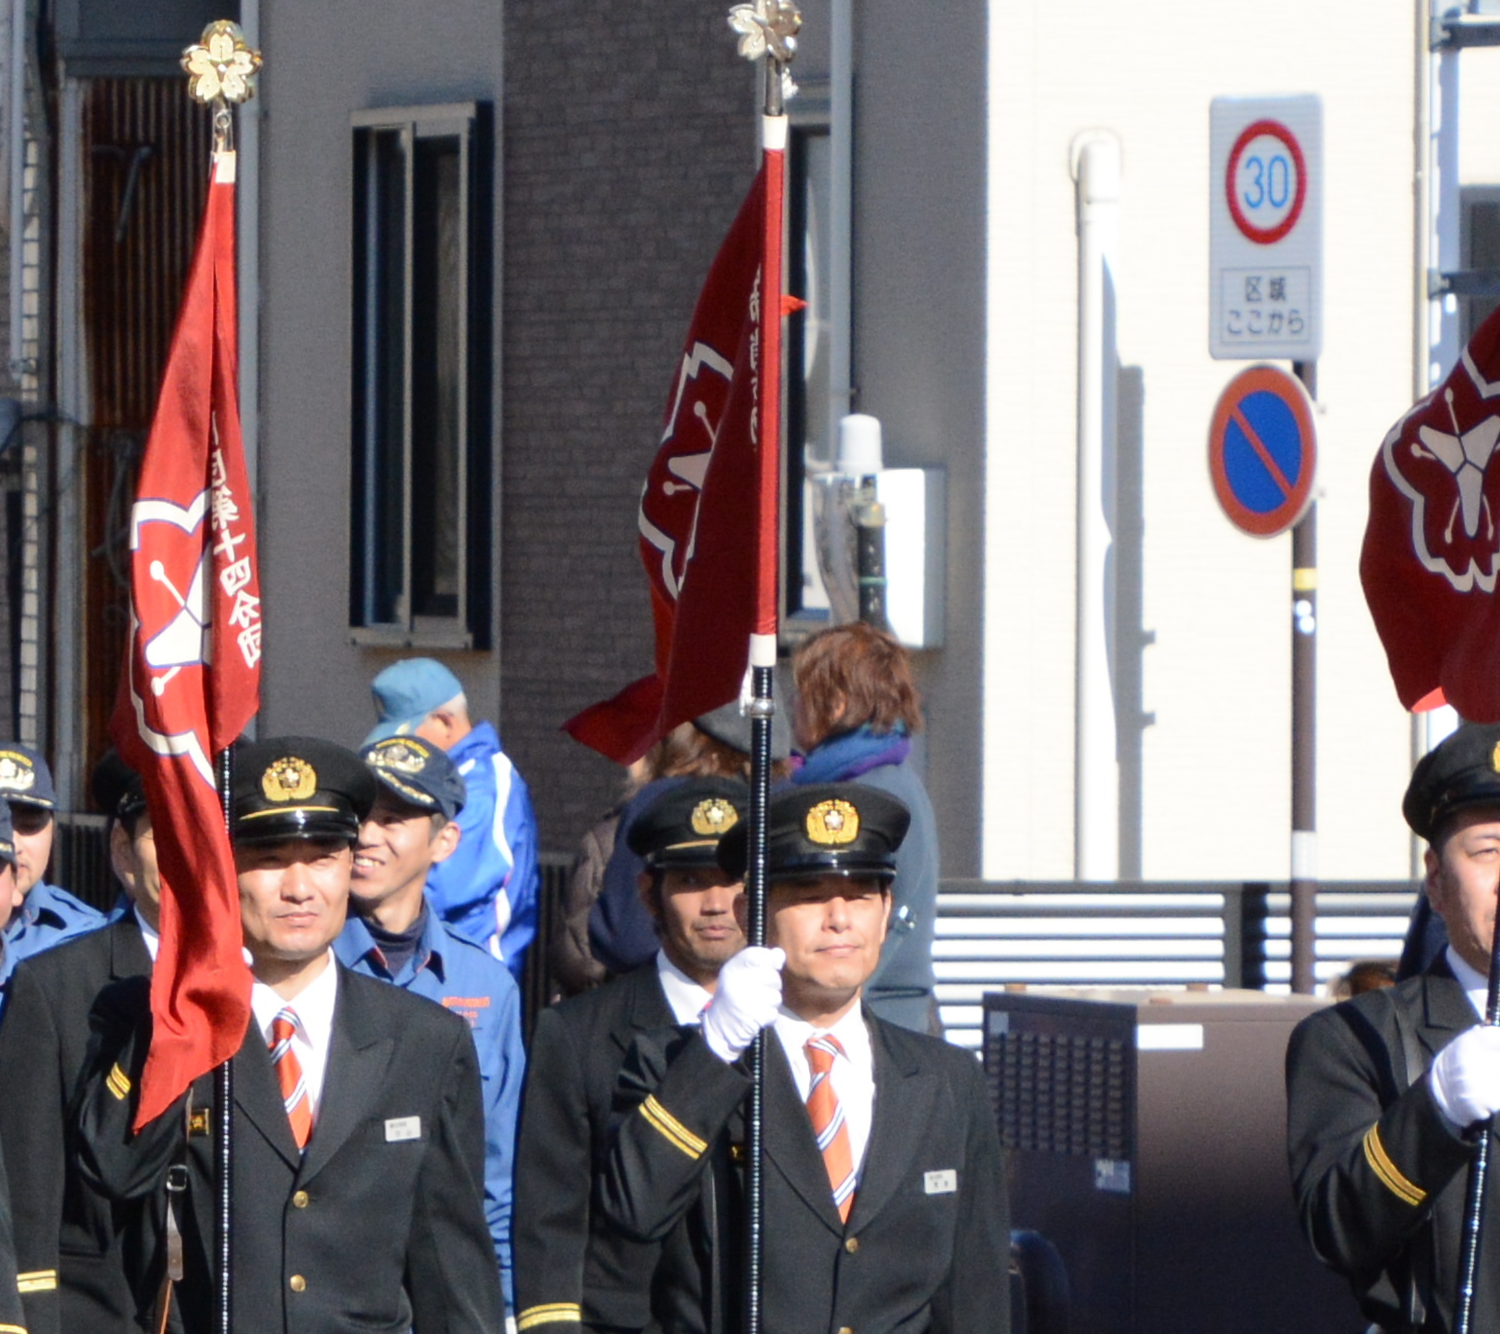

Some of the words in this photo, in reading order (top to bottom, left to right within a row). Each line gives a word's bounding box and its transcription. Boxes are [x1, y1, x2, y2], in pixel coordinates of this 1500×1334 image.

[1244, 155, 1290, 209] 30
[1245, 276, 1286, 302] 区域
[1227, 309, 1303, 336] ここから
